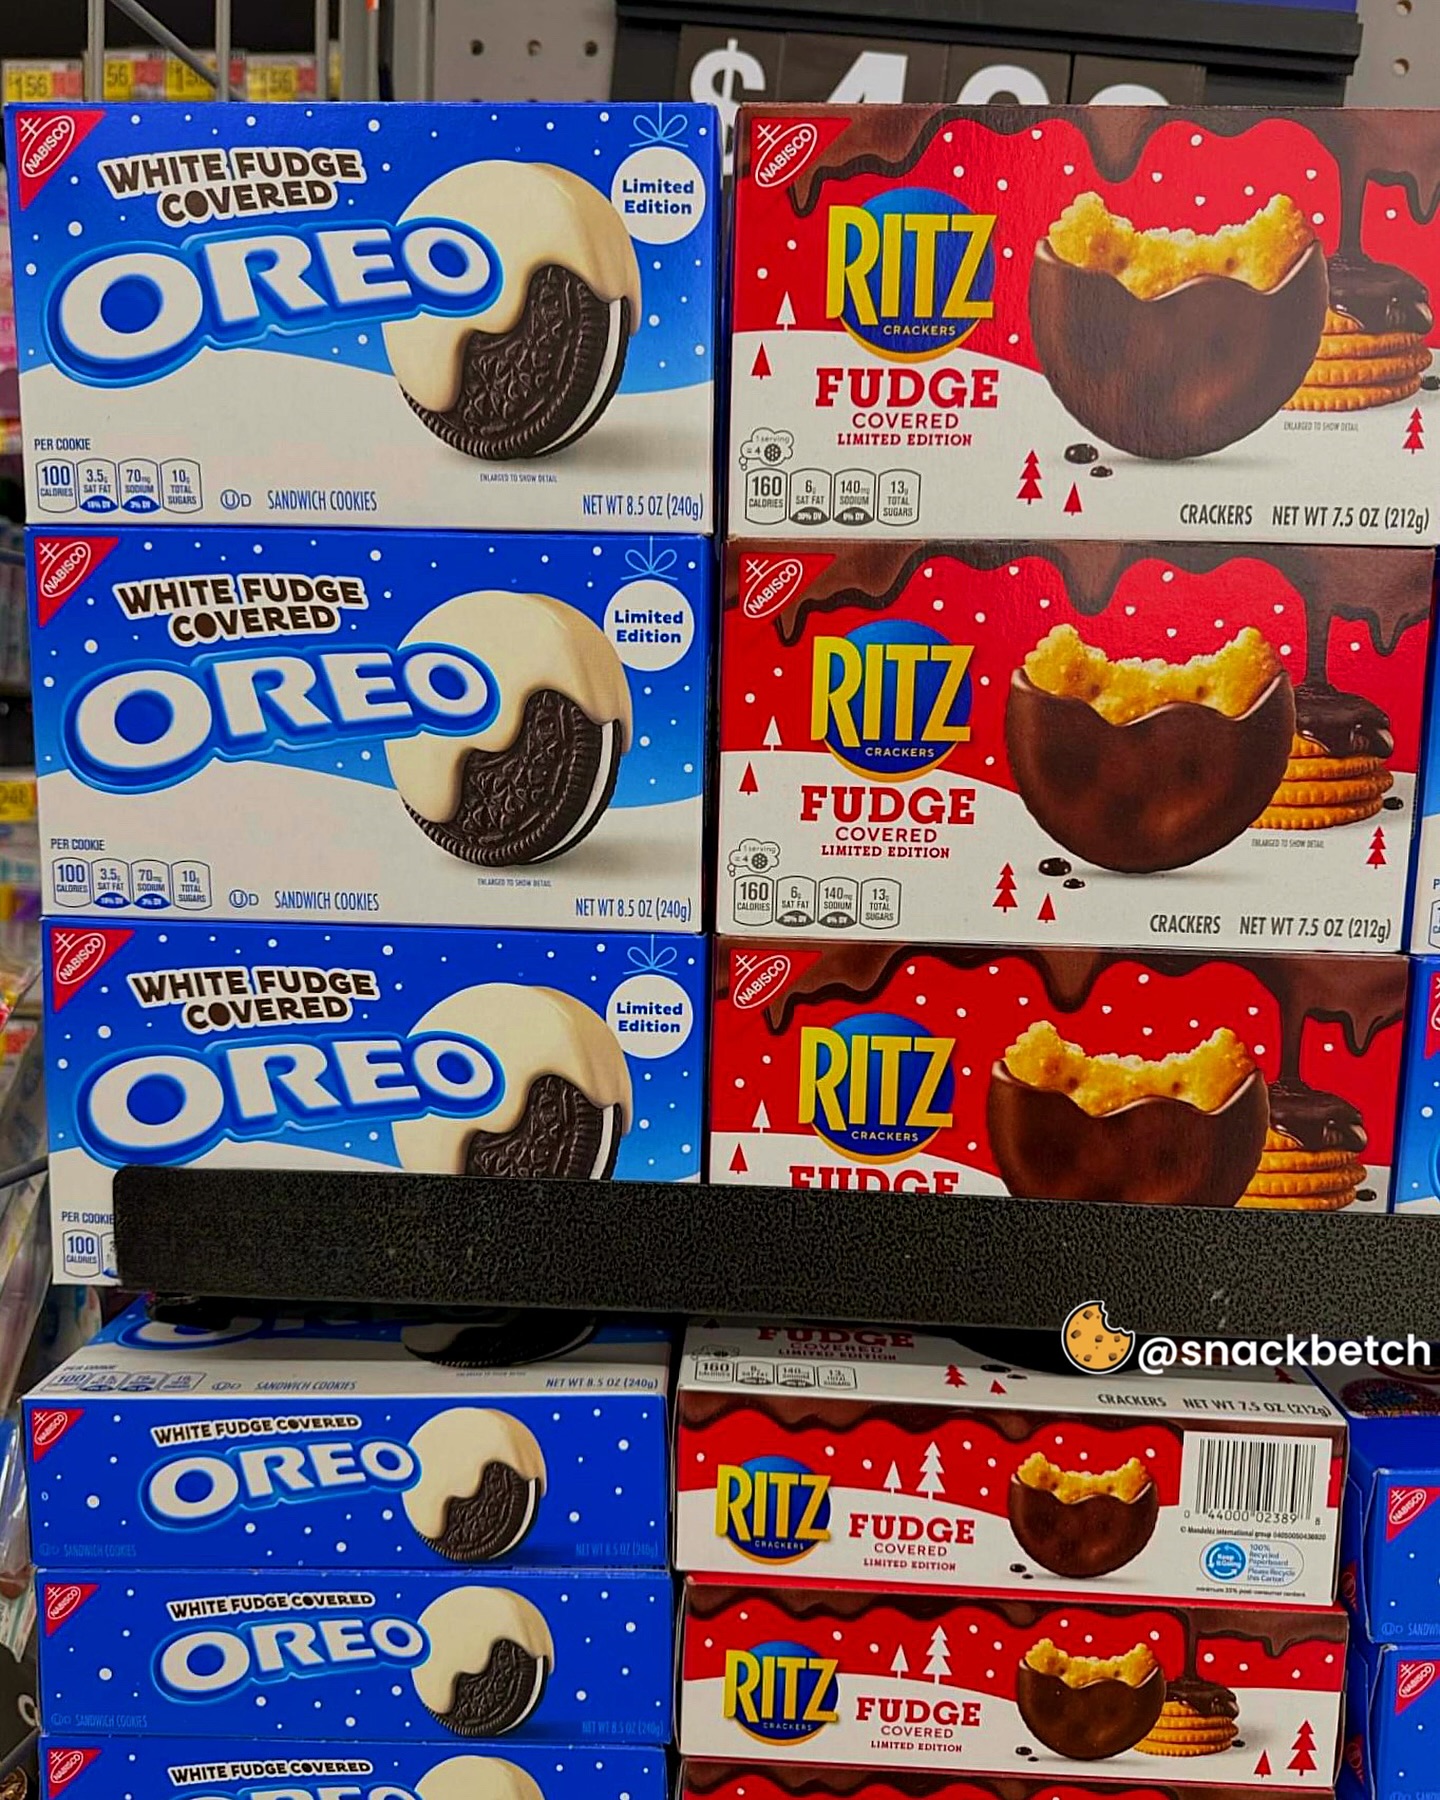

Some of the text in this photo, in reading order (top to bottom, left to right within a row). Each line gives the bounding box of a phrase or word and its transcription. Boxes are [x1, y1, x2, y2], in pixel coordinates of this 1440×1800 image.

[25, 121, 70, 173] NABISCO
[758, 129, 813, 185] NABISCO
[103, 151, 361, 194] WHITE FUDGE
[622, 178, 695, 194] Limited
[162, 180, 333, 223] COVERED
[624, 199, 692, 215] Edition
[826, 205, 997, 327] RITZ
[58, 225, 490, 359] OREO
[882, 324, 956, 336] CRACKERS
[815, 367, 1000, 409] FUDGE
[852, 412, 959, 430] COVERED
[34, 438, 91, 451] PER COOKIE
[837, 433, 972, 447] LIMITED EDITION
[42, 465, 71, 486] 100
[40, 487, 74, 497] CALORIES
[84, 485, 112, 494] SAT FAT
[125, 485, 154, 494] SODIUM
[170, 485, 193, 494] TOTAL
[752, 475, 782, 497] 160
[167, 495, 197, 505] SUGARS
[267, 489, 378, 513] SANDWICH COOKIES
[582, 494, 704, 521] NET WT 8.5 OZ (240g)
[749, 498, 784, 508] CALORIES
[795, 496, 825, 505] SAT FAT
[839, 496, 870, 505] SODIUM
[887, 496, 910, 506] TOTAL
[883, 507, 913, 517] SUGARS
[1180, 503, 1430, 535] CRACKERS NET WT 7.5 OZ (212g)
[44, 545, 87, 594] NABISCO
[118, 576, 364, 615] WHITE FUDGE
[747, 562, 798, 614] NABISCO
[171, 605, 336, 643] COVERED
[614, 609, 684, 624] Limited
[616, 629, 682, 643] Edition
[810, 635, 976, 748] RITZ
[75, 651, 489, 769] OREO
[865, 747, 935, 758] CRACKERS
[800, 785, 976, 825] FUDGE
[835, 826, 938, 843] COVERED
[50, 838, 106, 851] PER COOKIE
[821, 845, 950, 859] LIMITED EDITION
[57, 864, 85, 883] 100
[56, 884, 88, 893] CALORIES
[112, 882, 124, 891] FAT
[137, 883, 165, 892] SODIUM
[181, 884, 202, 893] TOTAL
[740, 881, 769, 900] 160
[274, 890, 380, 912] SANDWICH COOKIES
[575, 896, 692, 923] NET WT 8.5 OZ (240g)
[737, 901, 770, 911] CALORIES
[781, 900, 809, 909] SAT FAT
[823, 900, 853, 910] SODIUM
[869, 902, 891, 911] TOTAL
[865, 911, 894, 921] SUGARS
[1149, 913, 1391, 944] CRACKERS NET WT 7.5 OZ (212g)
[59, 936, 102, 981] NABISCO
[131, 969, 375, 1004] WHITE FUDGE
[736, 959, 786, 1005] NABISCO
[186, 997, 348, 1030] COVERED
[616, 1001, 683, 1015] Limited
[618, 1019, 681, 1033] Edition
[797, 1025, 957, 1131] RITZ
[88, 1038, 494, 1148] OREO
[850, 1131, 919, 1142] CRACKERS
[61, 1210, 115, 1225] PER COOKIE
[67, 1235, 95, 1255] 100
[757, 1326, 914, 1348] FUDGE
[778, 1348, 897, 1361] LIMITED EDITION
[790, 1343, 883, 1353] COVERED
[256, 1380, 357, 1391] SANDWICH COOKIES
[545, 1377, 565, 1388] NET
[568, 1378, 584, 1388] WT
[606, 1379, 621, 1388] OZ
[1098, 1393, 1332, 1418] CRACKERS NET WT 7.5 OZ (212g)
[38, 1413, 64, 1444] NABISCO
[154, 1416, 359, 1445] WHITE FUDGE COVERED
[148, 1441, 415, 1519] OREO
[714, 1463, 831, 1542] RITZ
[1391, 1491, 1424, 1522] NABISCO
[1183, 1510, 1298, 1525] 0 44000 02389
[848, 1513, 975, 1545] FUDGE
[63, 1543, 103, 1557] SANDWICH
[754, 1539, 805, 1551] CRACKERS
[874, 1543, 948, 1558] COVERED
[863, 1557, 956, 1571] LIMITED EDITION
[51, 1588, 78, 1618] NABISCO
[170, 1594, 374, 1619] WHITE FUDGE COVERED
[160, 1618, 424, 1692] OREO
[724, 1648, 839, 1723] RITZ
[1401, 1665, 1432, 1696] NABISCO
[855, 1696, 981, 1727] FUDGE
[75, 1714, 115, 1728] SANDWICH
[763, 1721, 813, 1732] CRACKERS
[880, 1725, 954, 1739] COVERED
[870, 1740, 962, 1753] LIMITED EDITION
[53, 1752, 81, 1782] NABISCO
[171, 1761, 372, 1784] WHITE FUDGE COVERED
